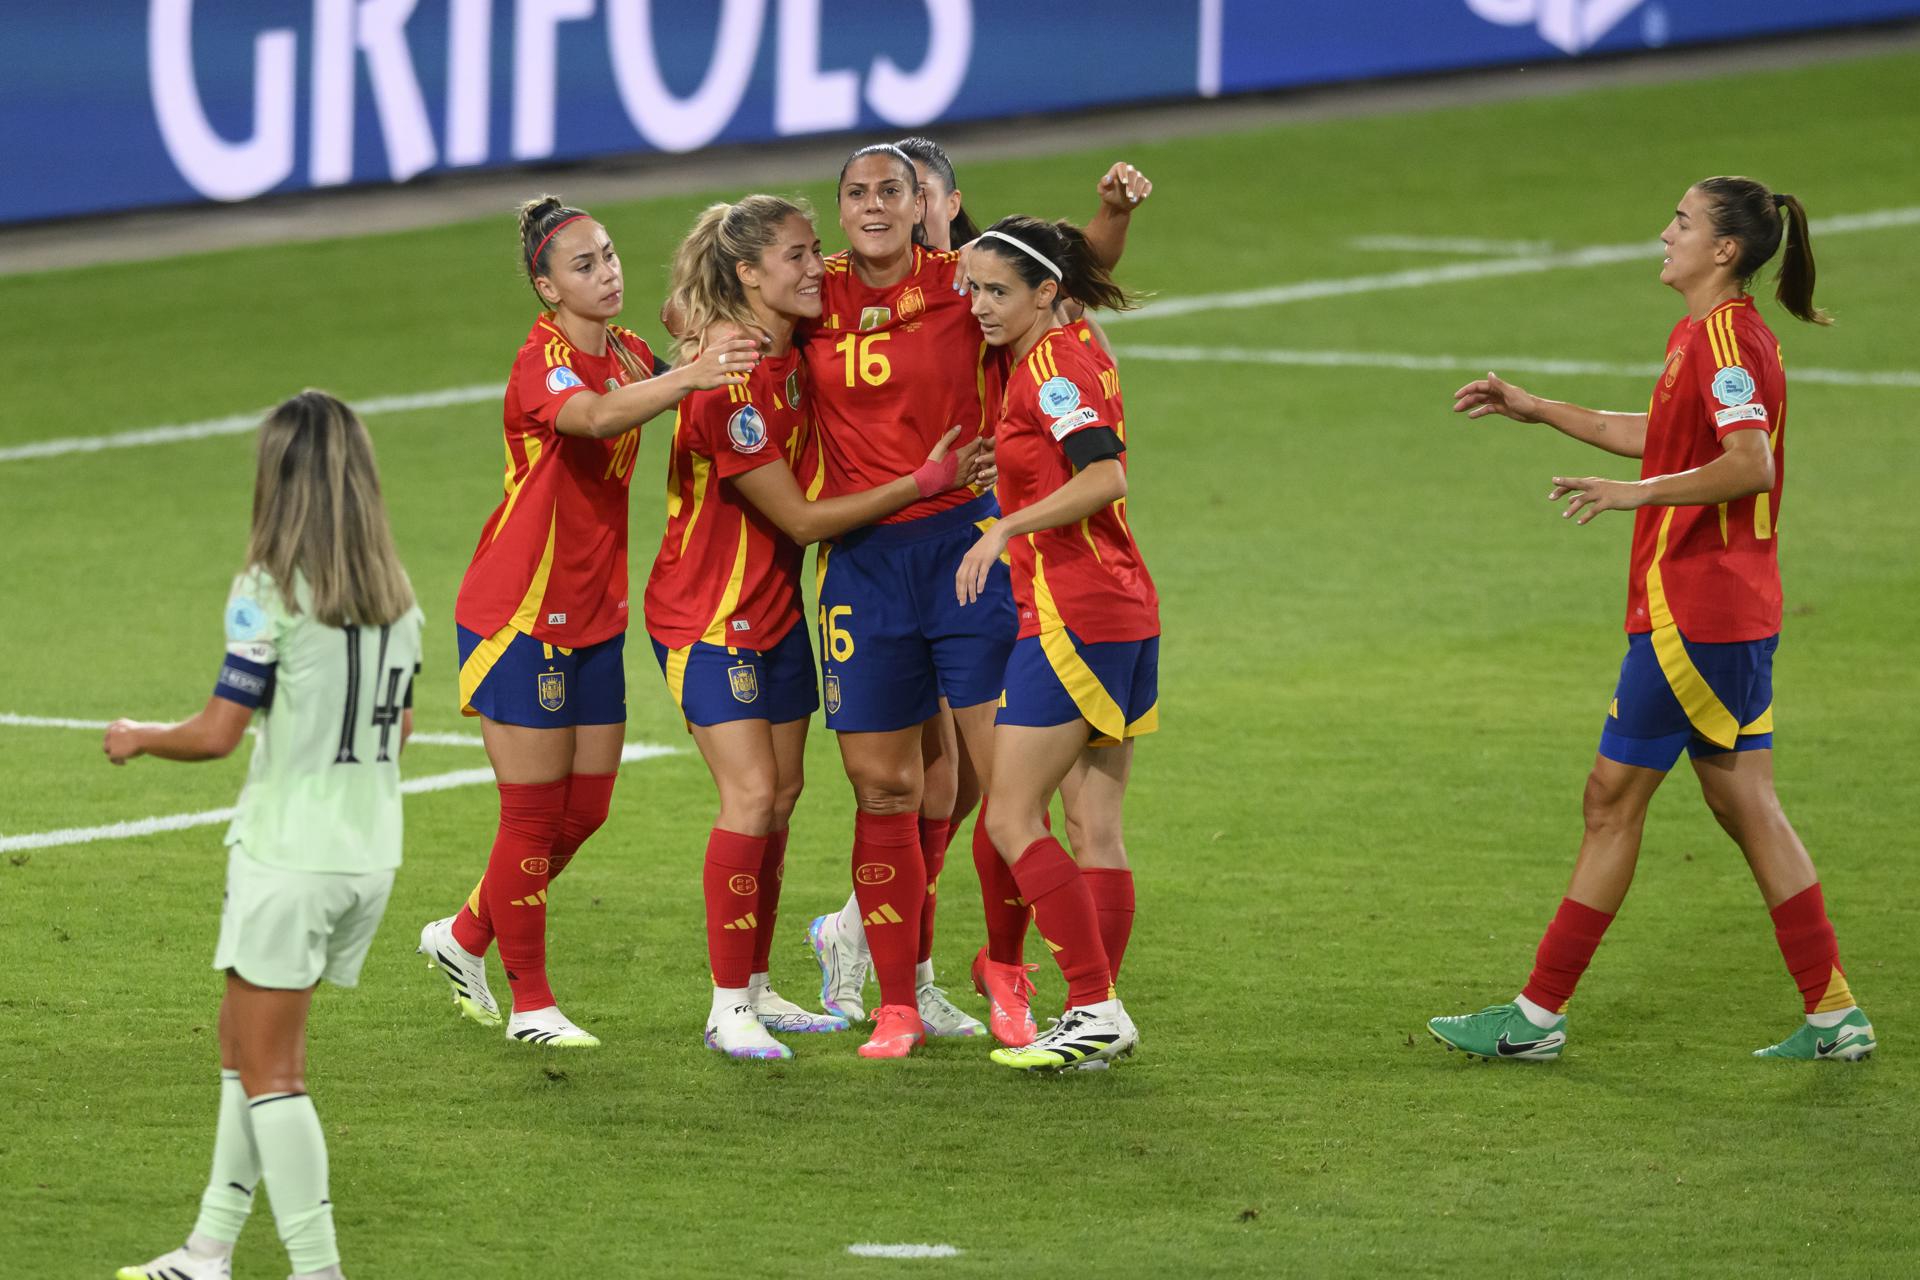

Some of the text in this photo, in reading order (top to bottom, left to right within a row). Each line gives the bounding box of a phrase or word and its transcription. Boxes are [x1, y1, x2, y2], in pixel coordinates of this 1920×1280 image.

[836, 332, 892, 388] 16
[603, 427, 638, 480] 10
[819, 604, 855, 663] 16
[334, 624, 405, 764] 14
